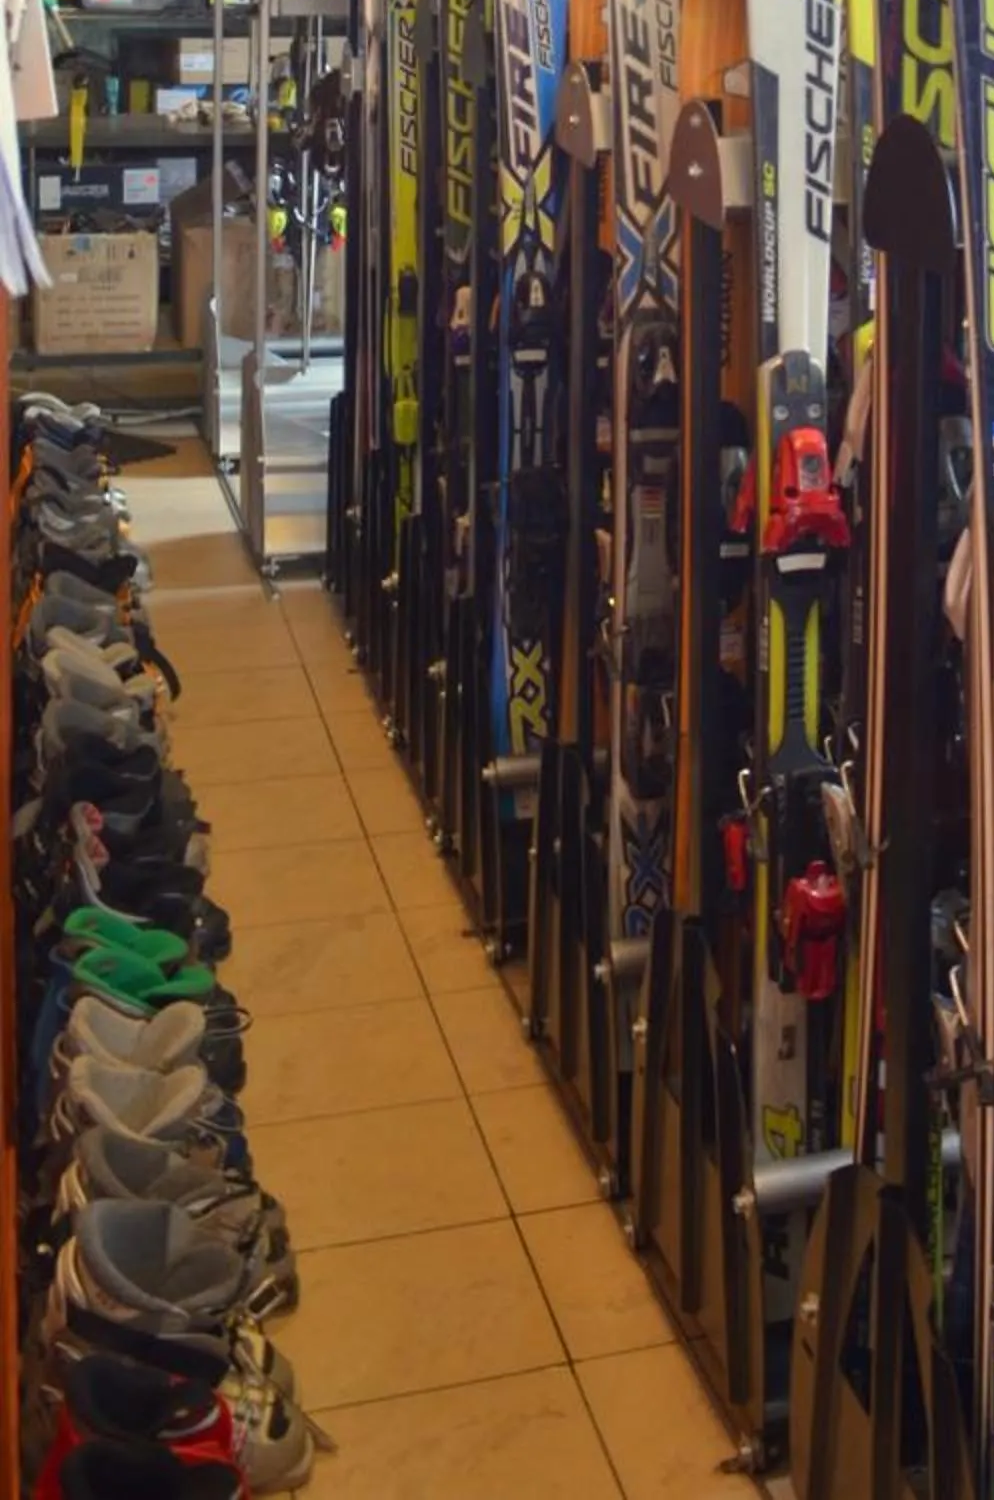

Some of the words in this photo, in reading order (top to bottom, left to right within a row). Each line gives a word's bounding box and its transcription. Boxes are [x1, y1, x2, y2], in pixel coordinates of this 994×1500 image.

[399, 16, 418, 177] FISCHER
[501, 4, 540, 170] FIRE
[619, 4, 657, 209] FIRE
[763, 162, 775, 197] SC
[763, 202, 776, 323] WORLDCUP
